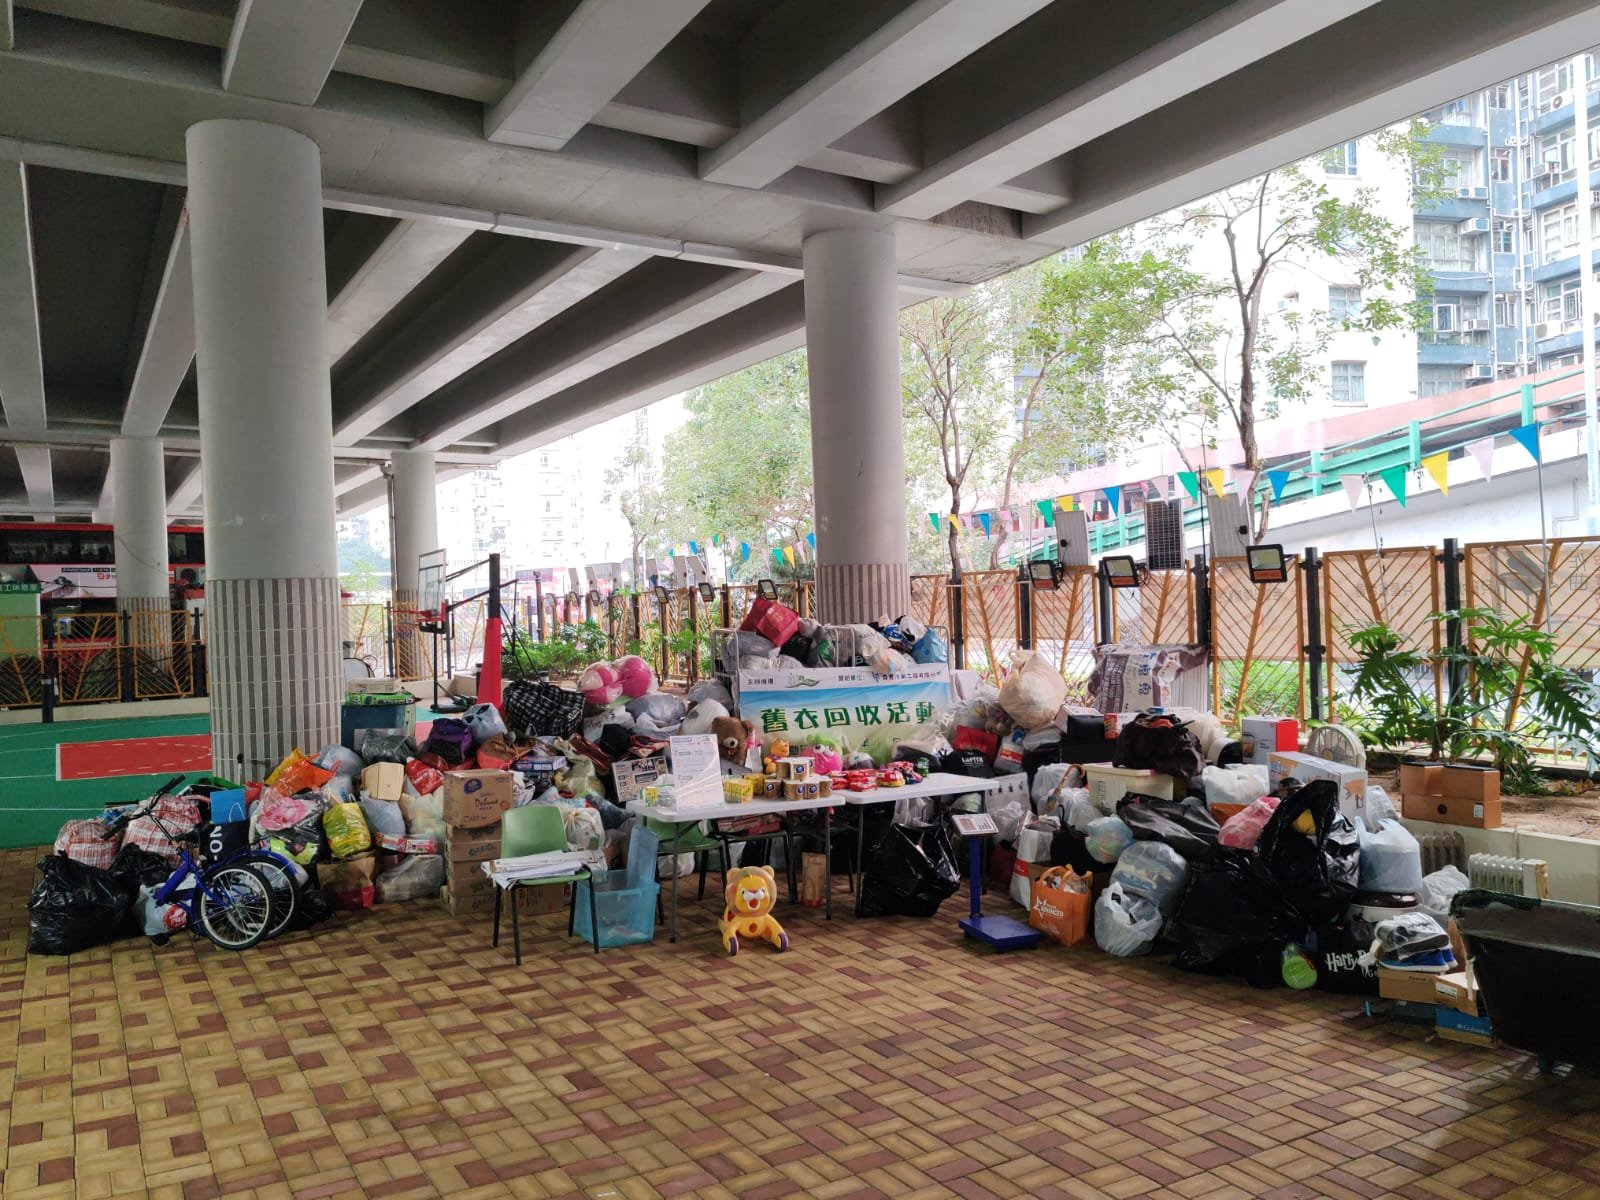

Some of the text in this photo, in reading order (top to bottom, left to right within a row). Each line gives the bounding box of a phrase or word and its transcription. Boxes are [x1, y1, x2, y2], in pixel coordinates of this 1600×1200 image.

[760, 701, 936, 734] 舊衣回收活動
[1325, 952, 1358, 972] Harry
